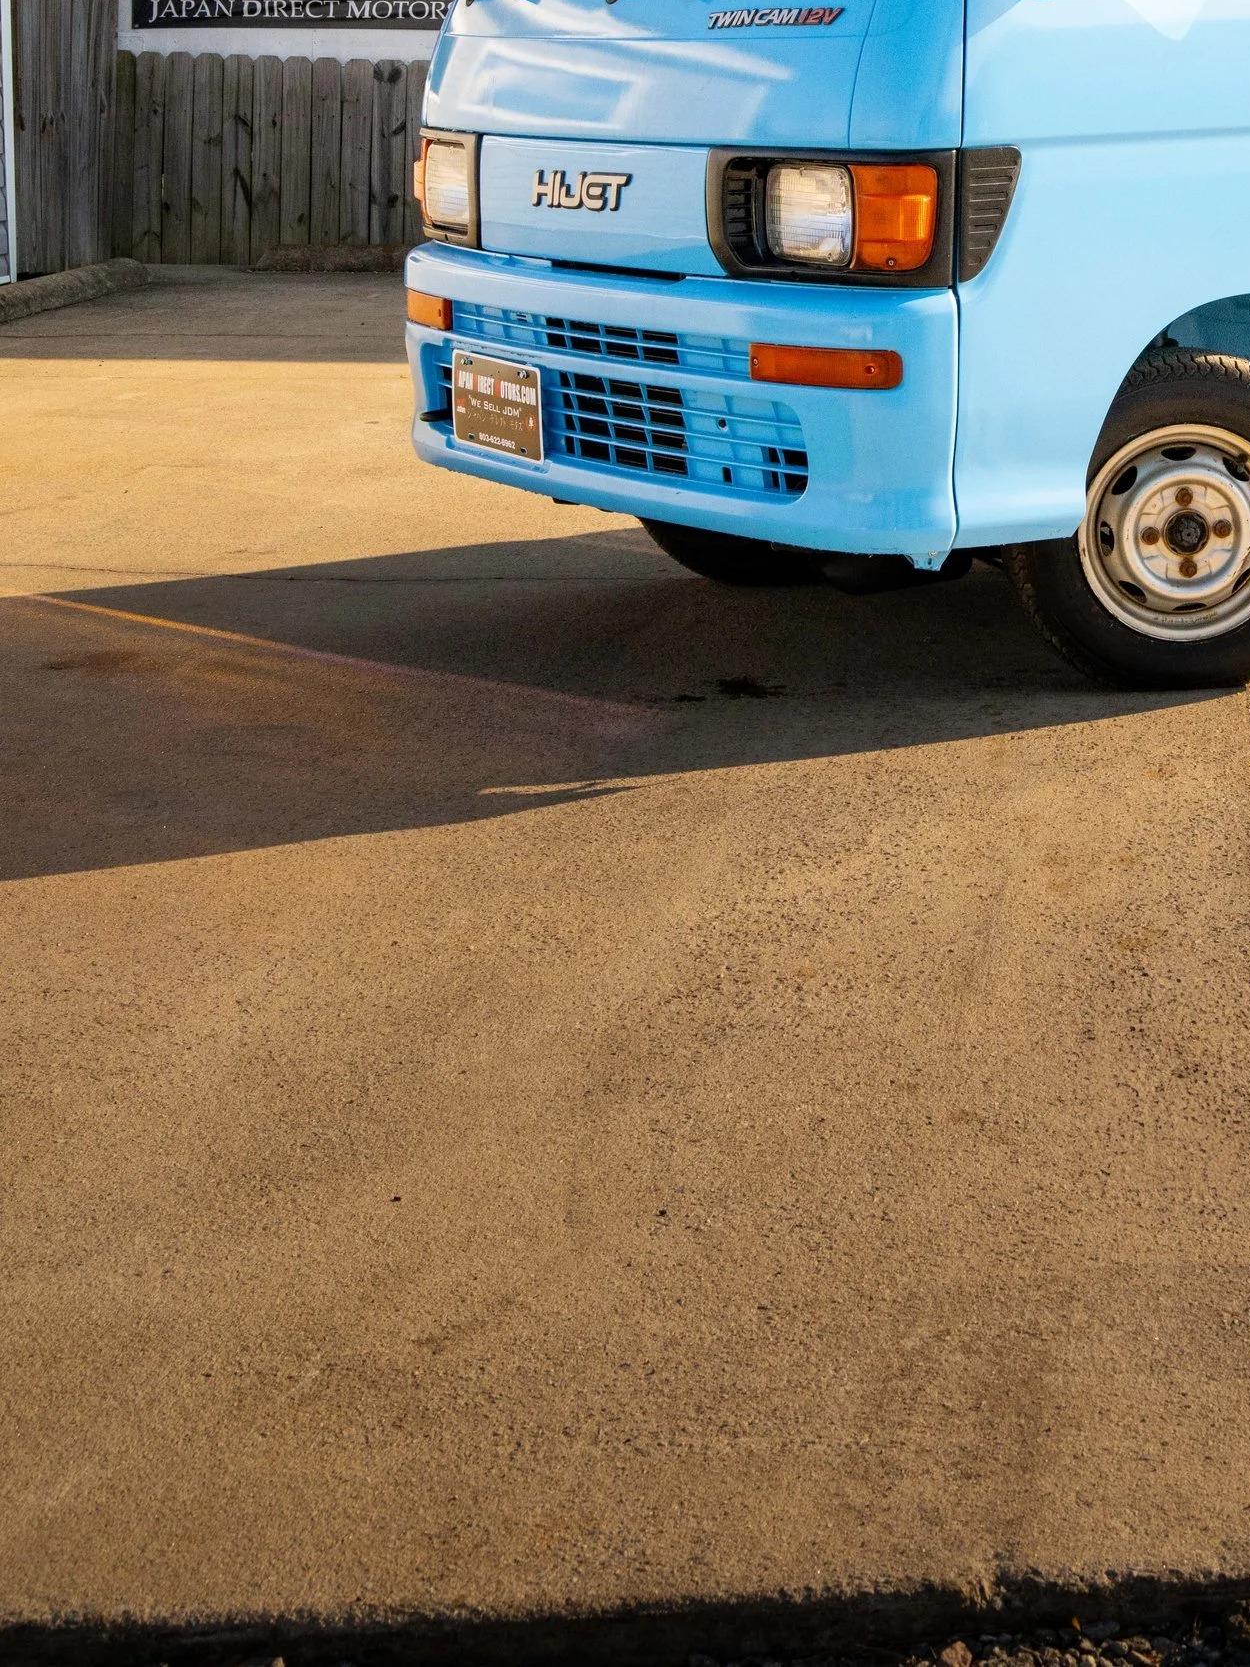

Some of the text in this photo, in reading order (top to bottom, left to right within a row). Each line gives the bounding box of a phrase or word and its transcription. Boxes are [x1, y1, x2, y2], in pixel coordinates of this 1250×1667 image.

[149, 0, 235, 22] JAPAN
[242, 0, 340, 19] DIRECT
[531, 169, 634, 212] HIJET
